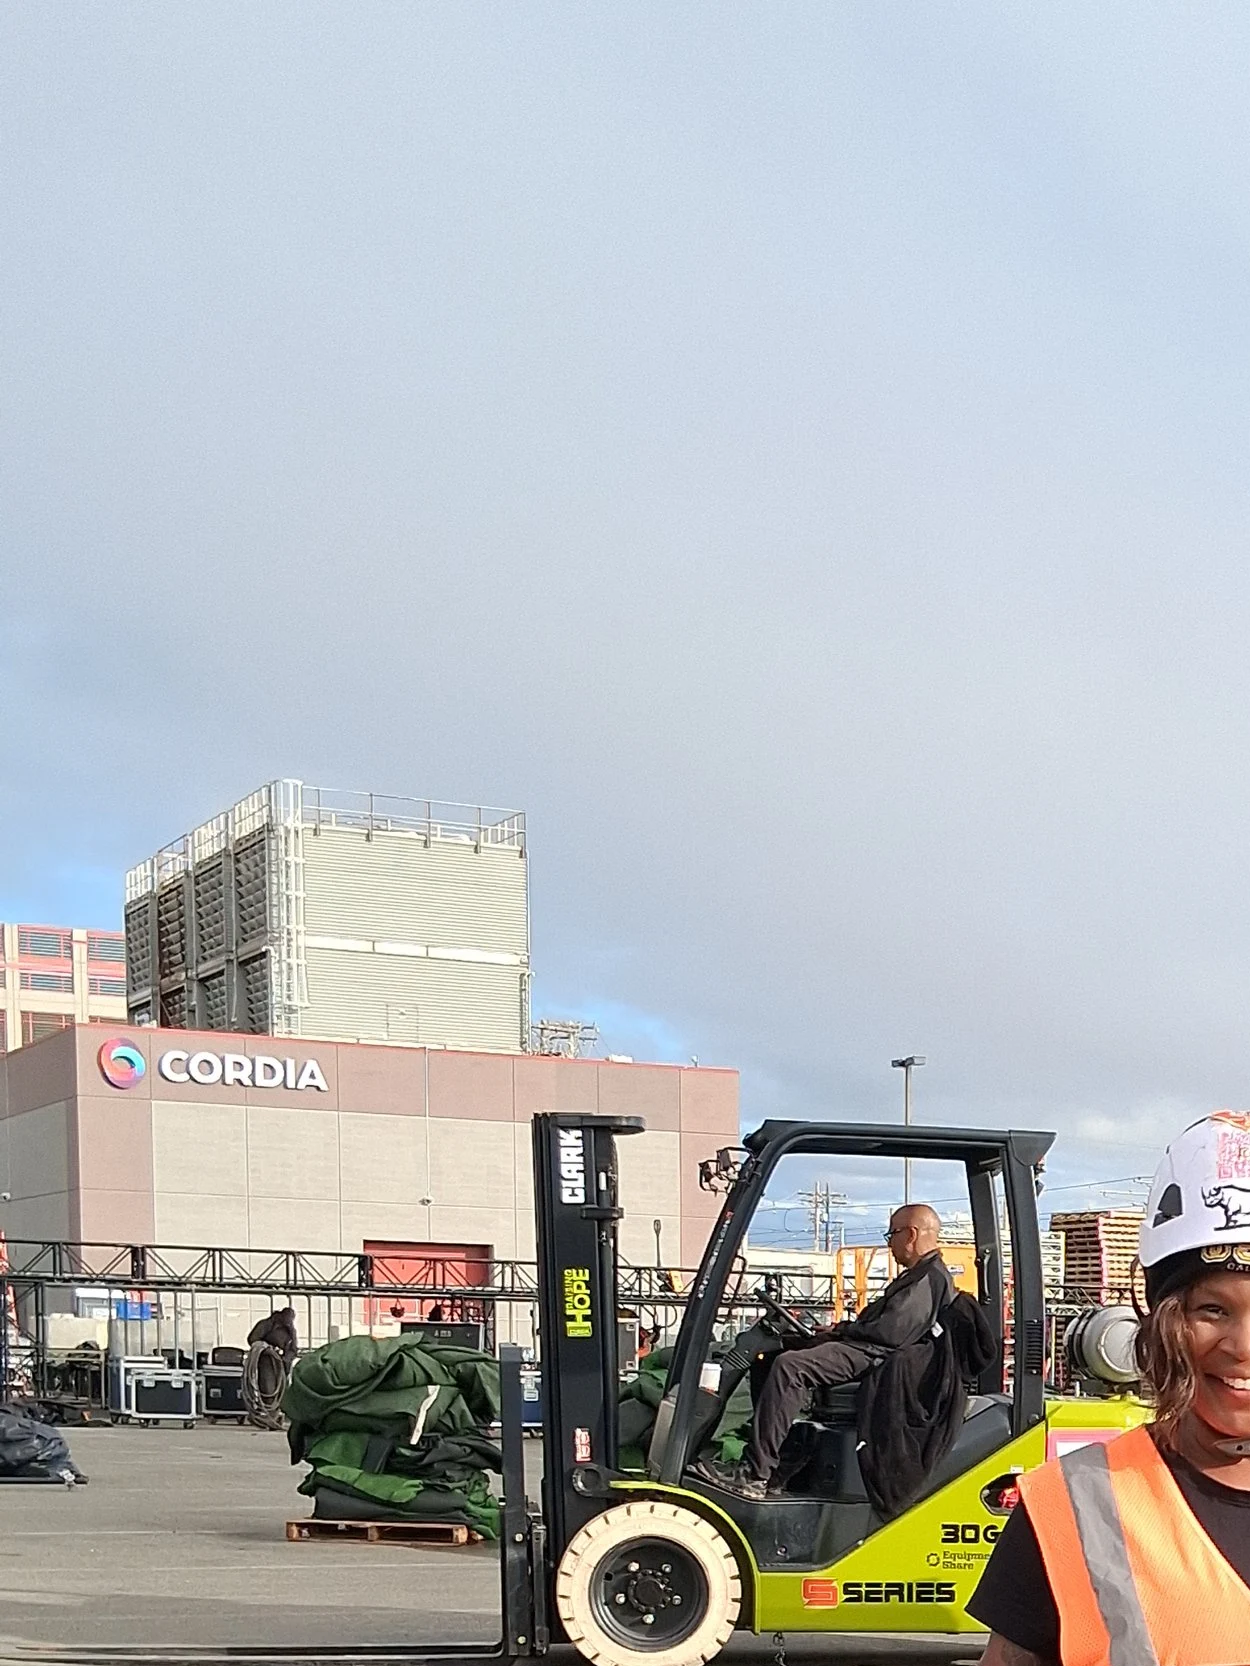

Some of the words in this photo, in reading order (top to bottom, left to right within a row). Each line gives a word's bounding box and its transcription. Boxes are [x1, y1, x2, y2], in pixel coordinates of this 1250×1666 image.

[158, 1050, 330, 1092] CORDIA
[558, 1128, 586, 1204] CLARK
[565, 1268, 592, 1327] HOPE
[942, 1561, 974, 1569] Share
[841, 1582, 957, 1603] SERIES
